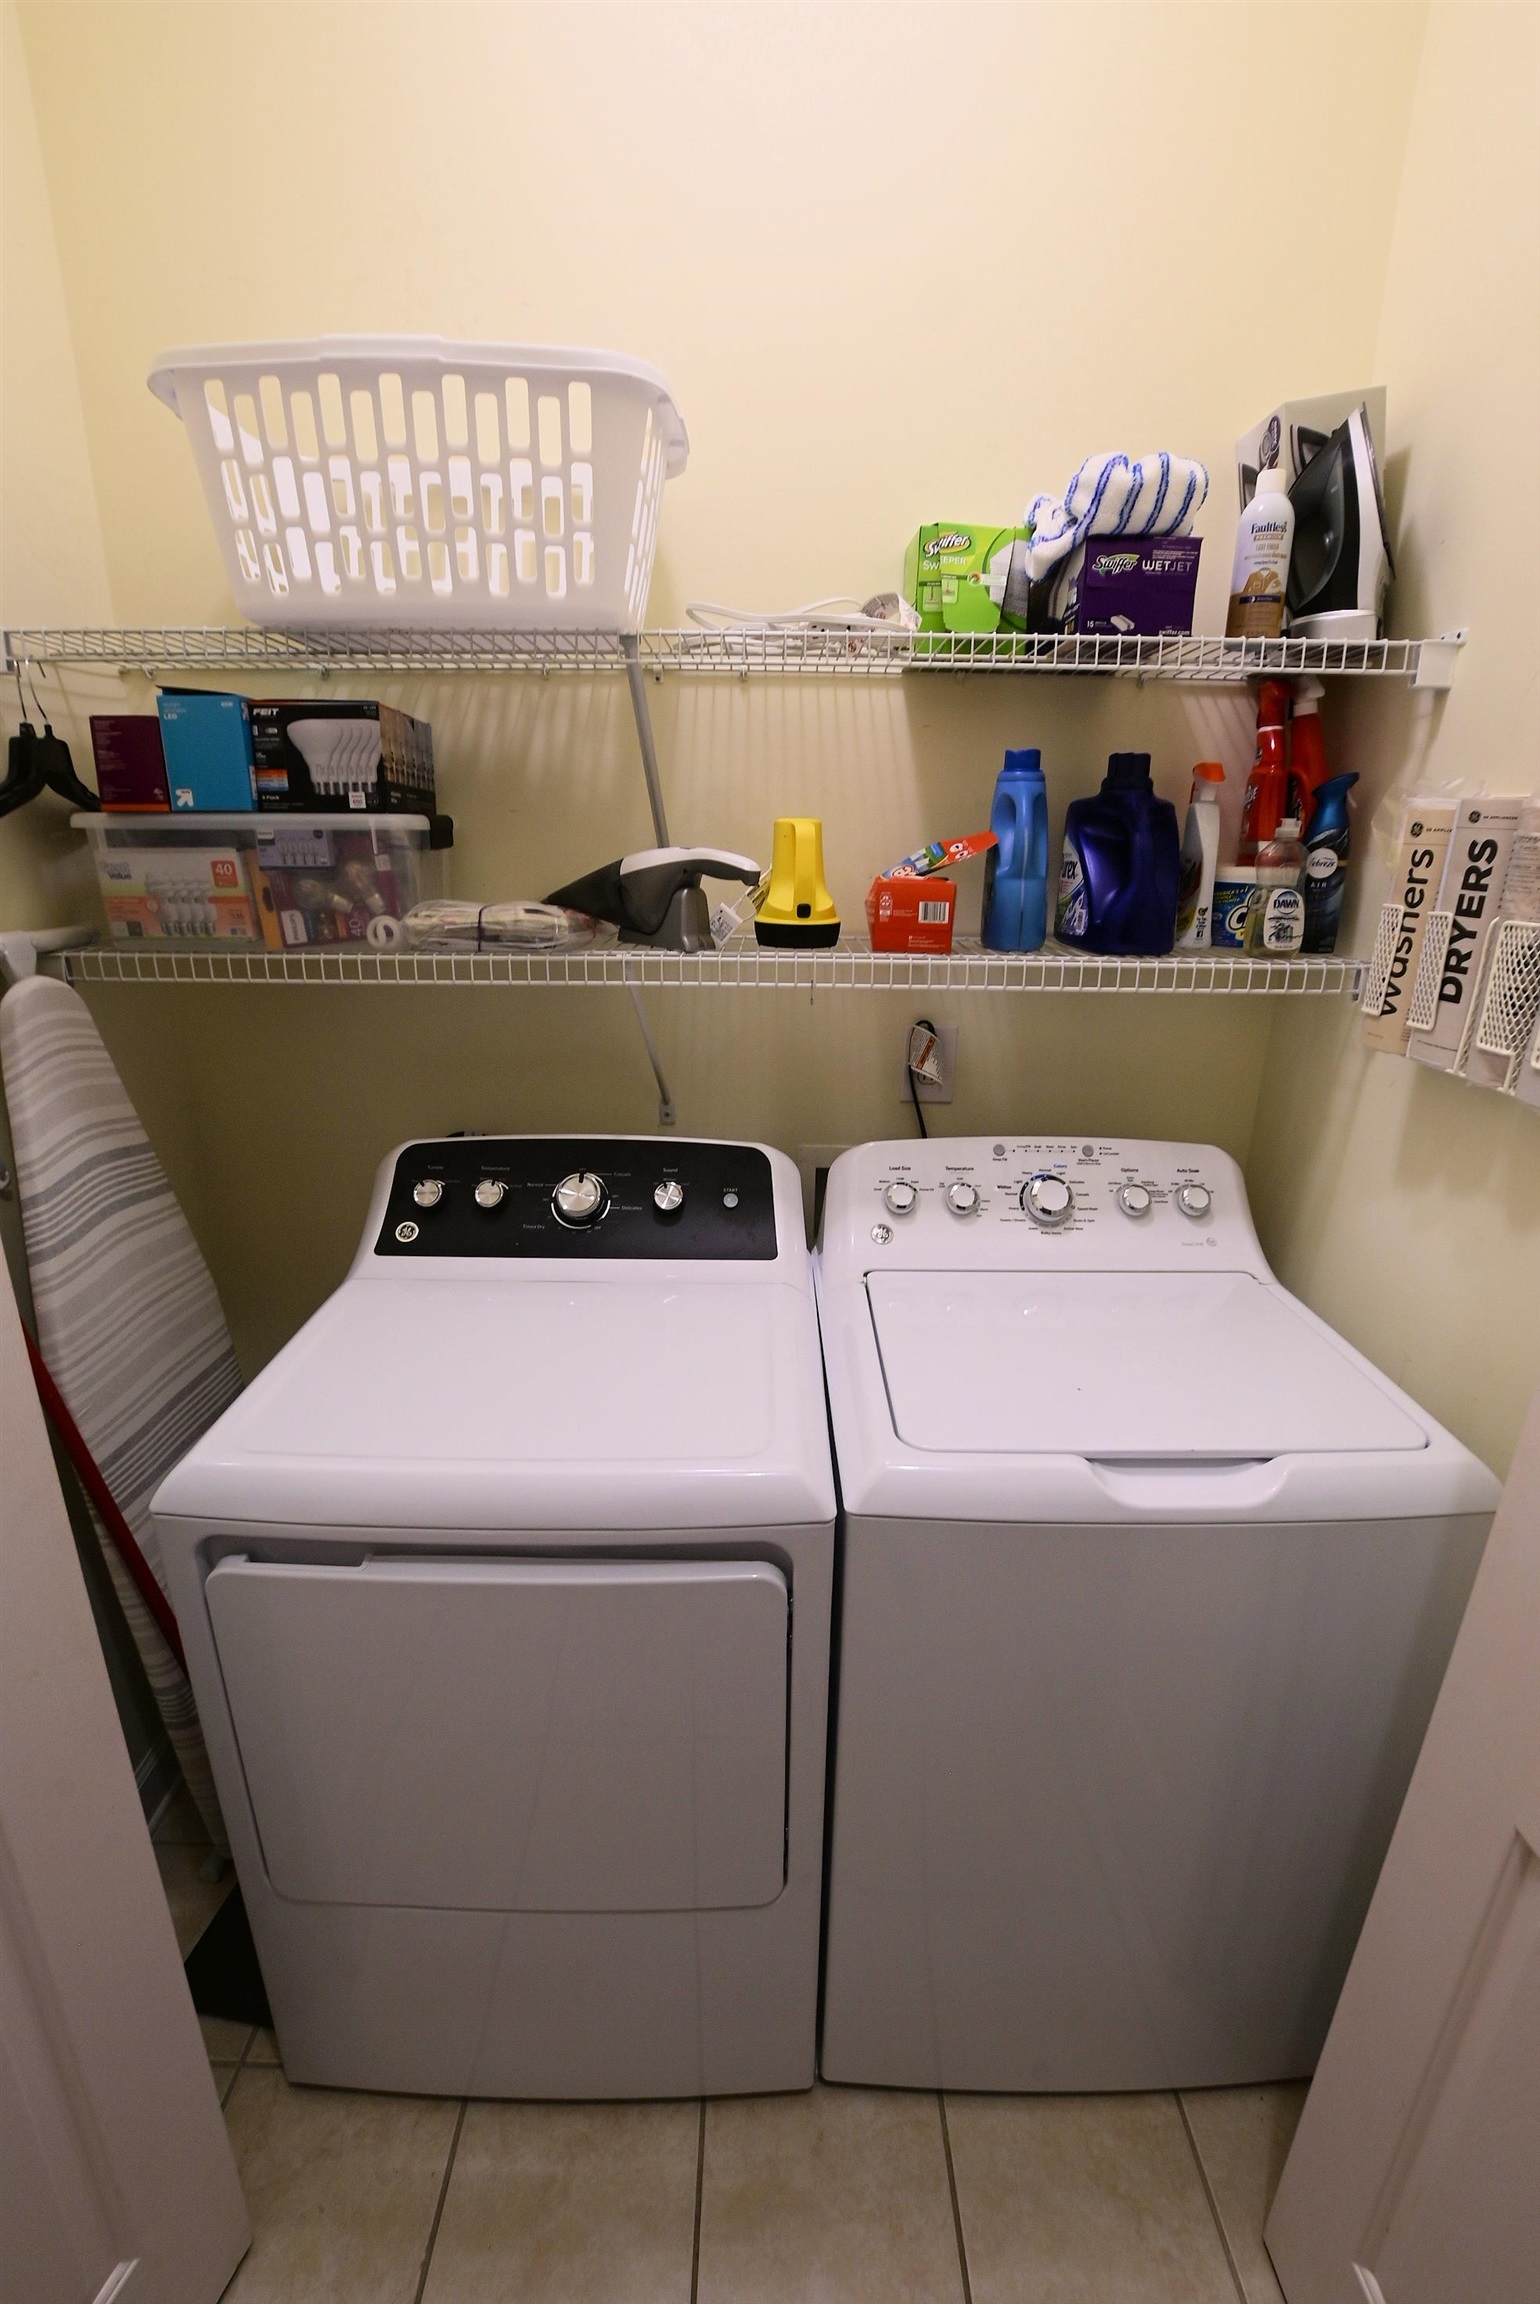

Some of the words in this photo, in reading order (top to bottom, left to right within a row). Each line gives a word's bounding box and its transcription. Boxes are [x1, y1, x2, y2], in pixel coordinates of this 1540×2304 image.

[1250, 521, 1288, 535] Faultless
[925, 533, 969, 558] Swiffer
[1092, 554, 1138, 575] Swiffer
[1142, 559, 1193, 572] WETJET
[163, 713, 178, 721] LED
[252, 707, 280, 717] FEIT
[215, 863, 233, 876] 40
[1273, 898, 1300, 910] DAWN
[1438, 838, 1499, 1005] DRYERS
[481, 1164, 511, 1172] Temperature
